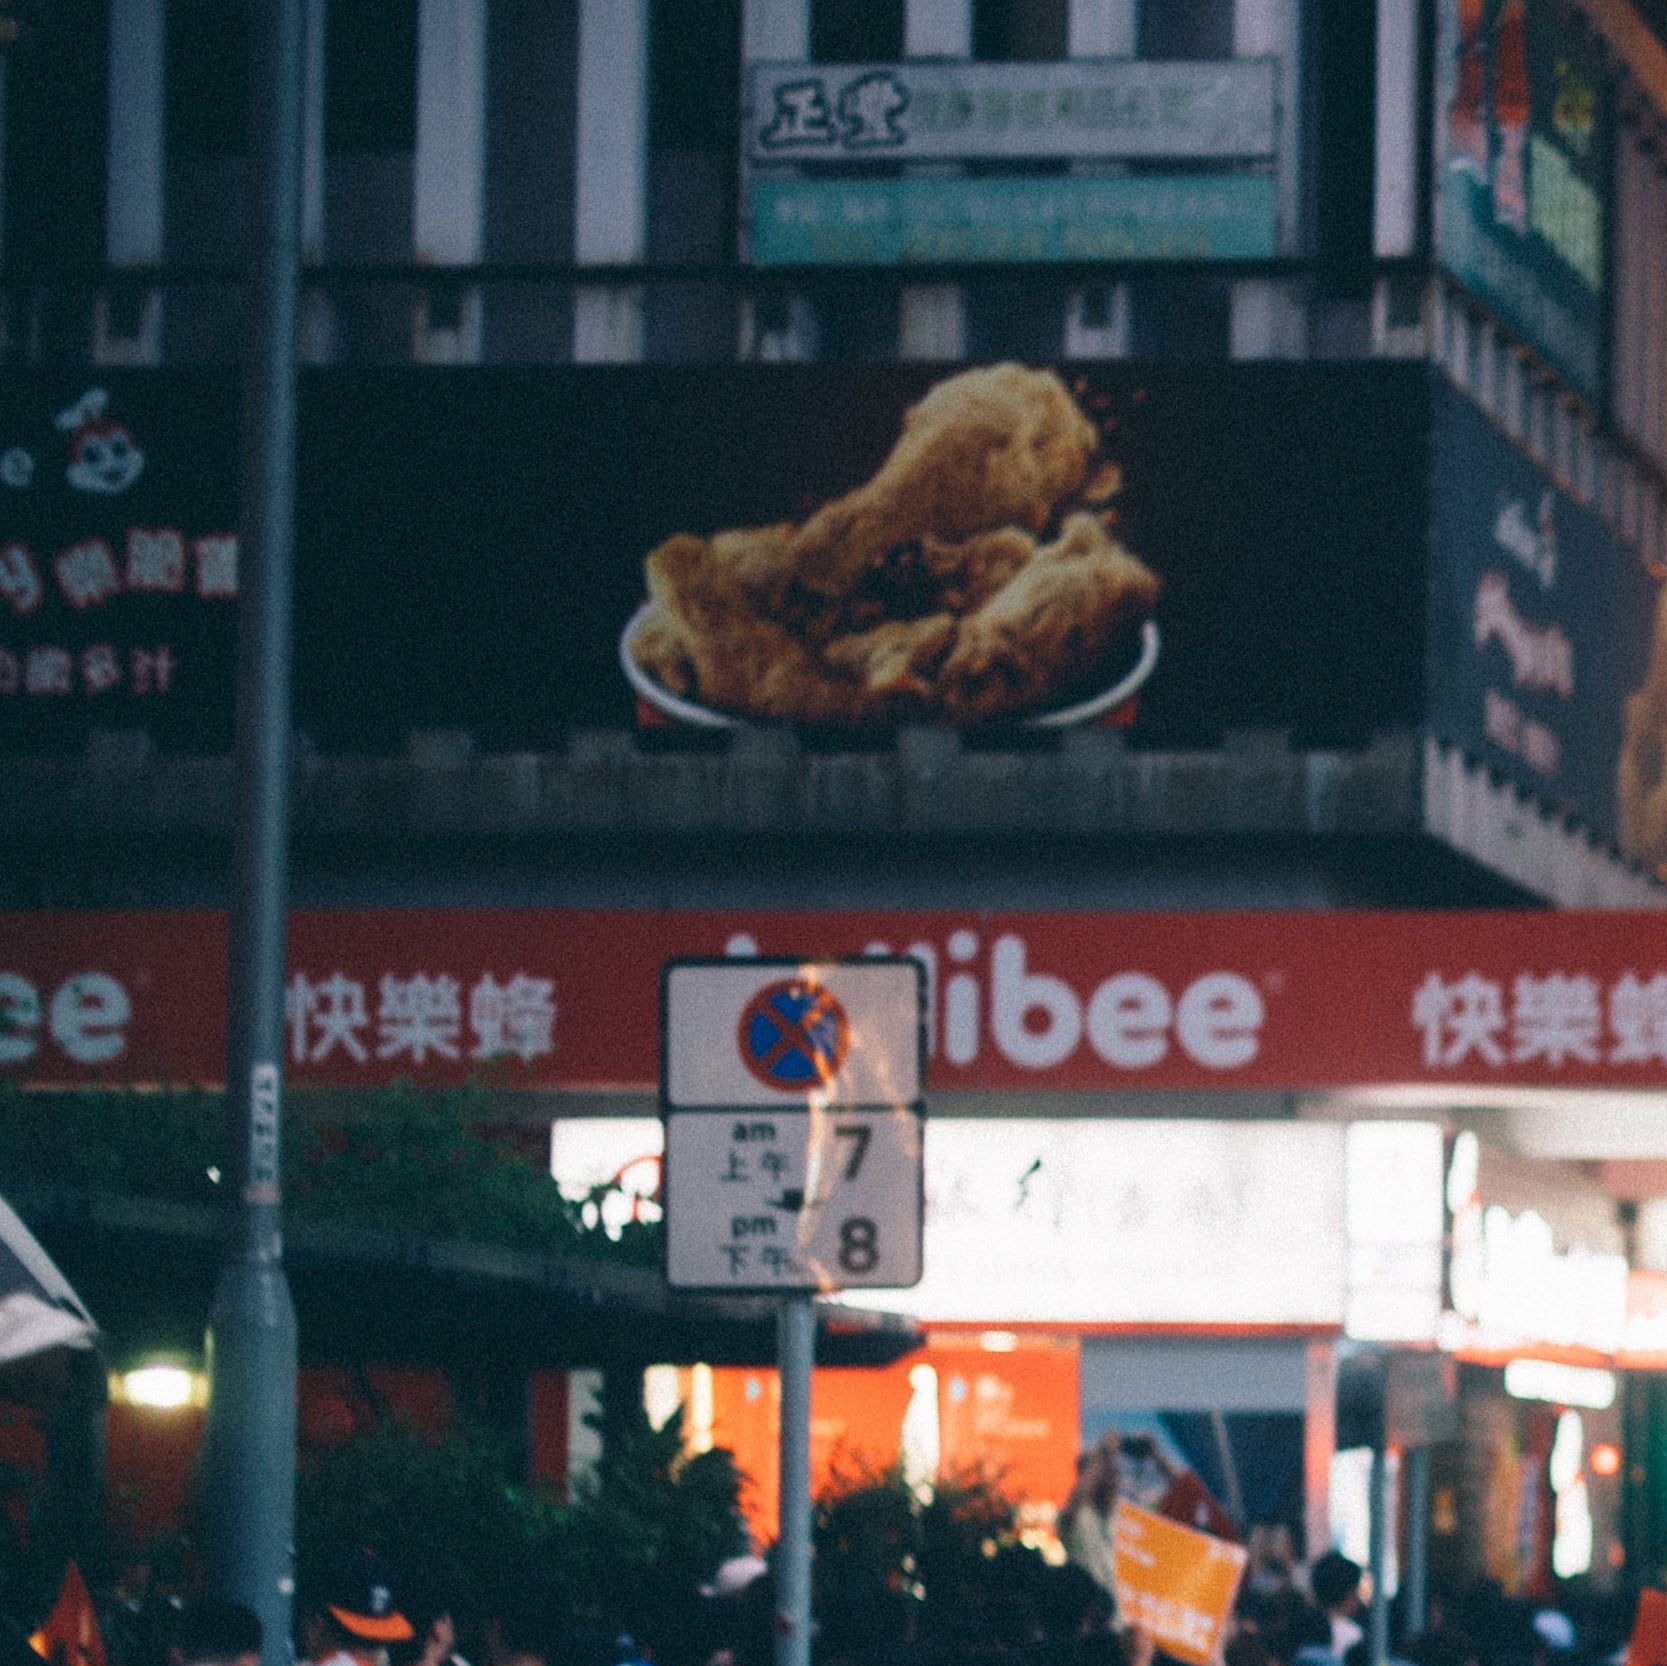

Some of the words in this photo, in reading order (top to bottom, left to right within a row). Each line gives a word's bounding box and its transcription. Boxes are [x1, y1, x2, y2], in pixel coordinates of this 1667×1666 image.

[285, 971, 559, 1064] 快樂蜂
[732, 1120, 776, 1143] am
[719, 1152, 790, 1183] 上午
[835, 1125, 871, 1182] 7
[732, 1215, 776, 1239] pm
[719, 1245, 790, 1275] 下午
[838, 1217, 880, 1275] 8
